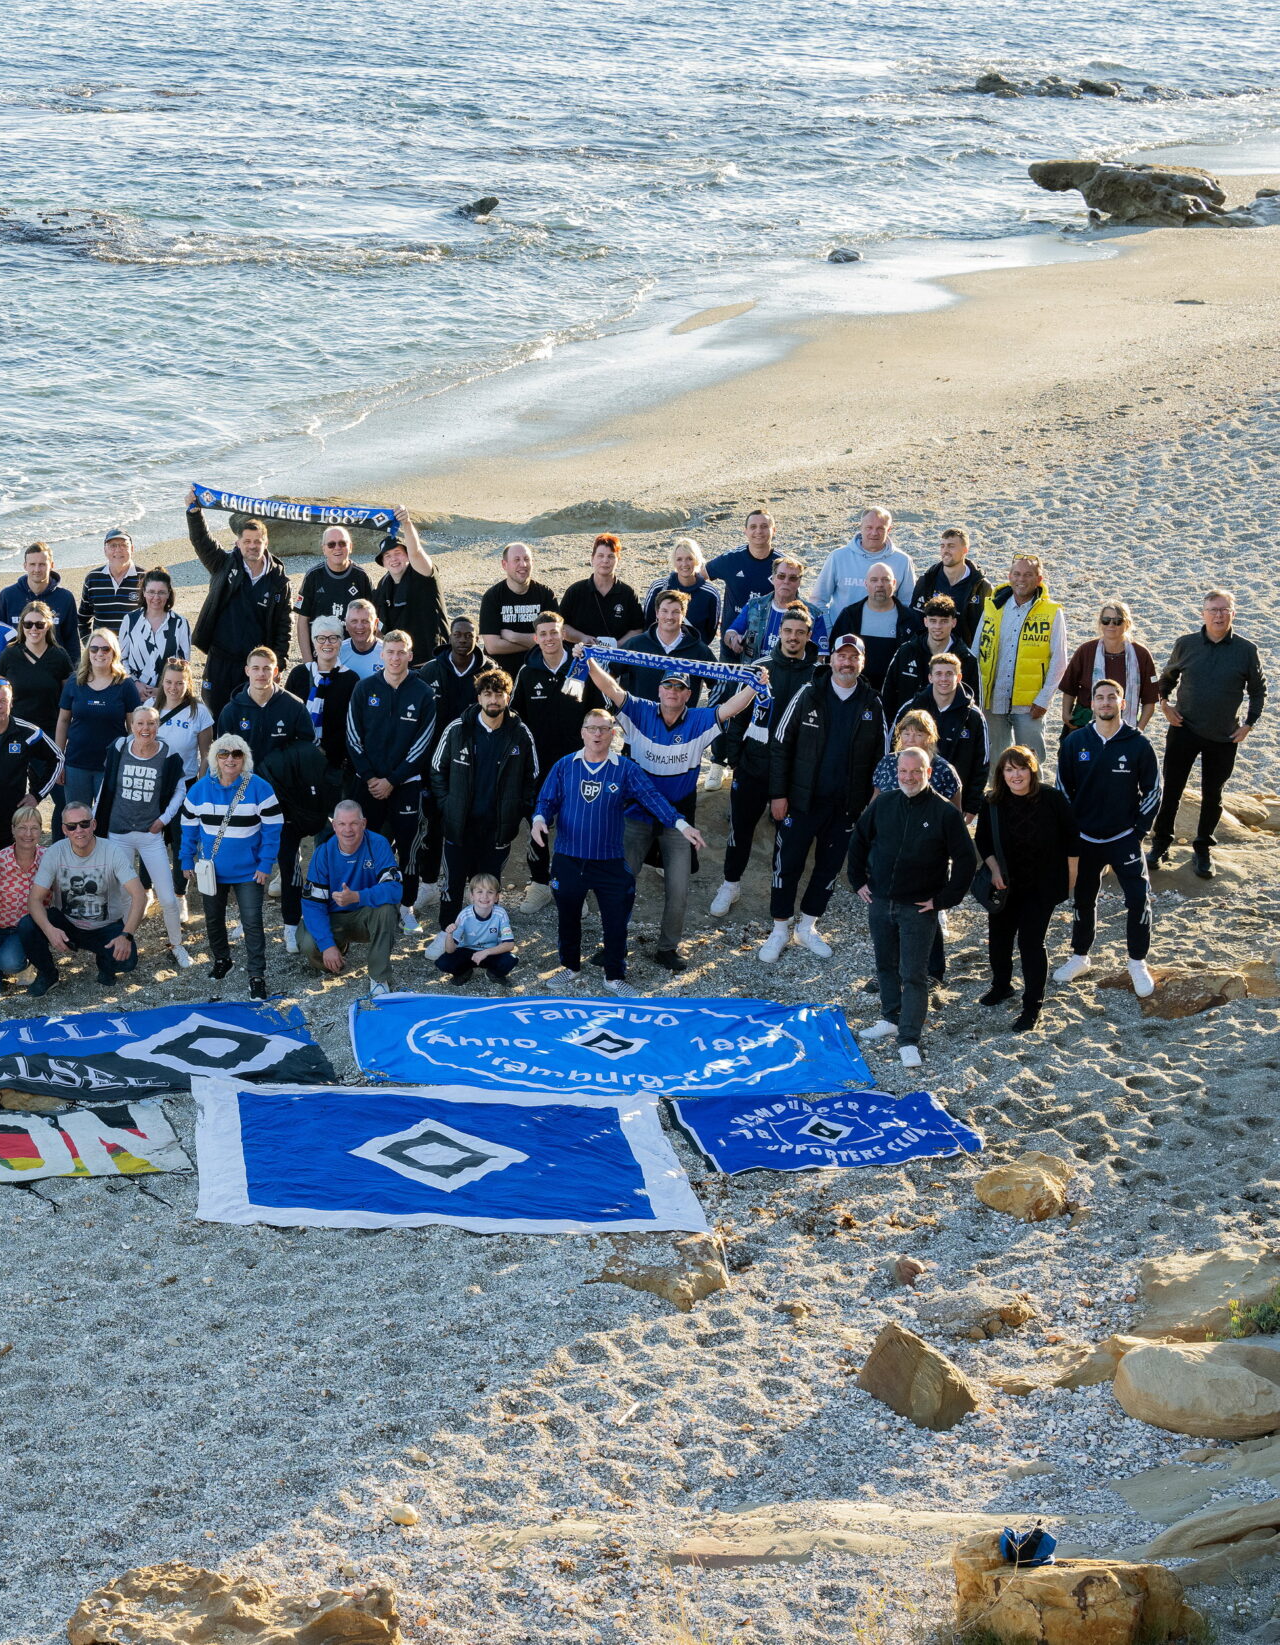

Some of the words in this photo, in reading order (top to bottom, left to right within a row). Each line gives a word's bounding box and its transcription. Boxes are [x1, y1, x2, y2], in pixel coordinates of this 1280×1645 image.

[221, 494, 311, 521] RAUTENPERLE
[319, 508, 370, 525] 1887
[1023, 621, 1050, 634] MP
[1022, 633, 1049, 642] DAVID
[123, 764, 157, 779] NUR
[122, 776, 156, 791] DER
[584, 784, 600, 797] BP
[121, 788, 154, 803] HSV
[510, 1008, 680, 1027] Fanclub
[427, 1033, 538, 1049] Anno
[764, 1144, 885, 1162] UPPORTERS
